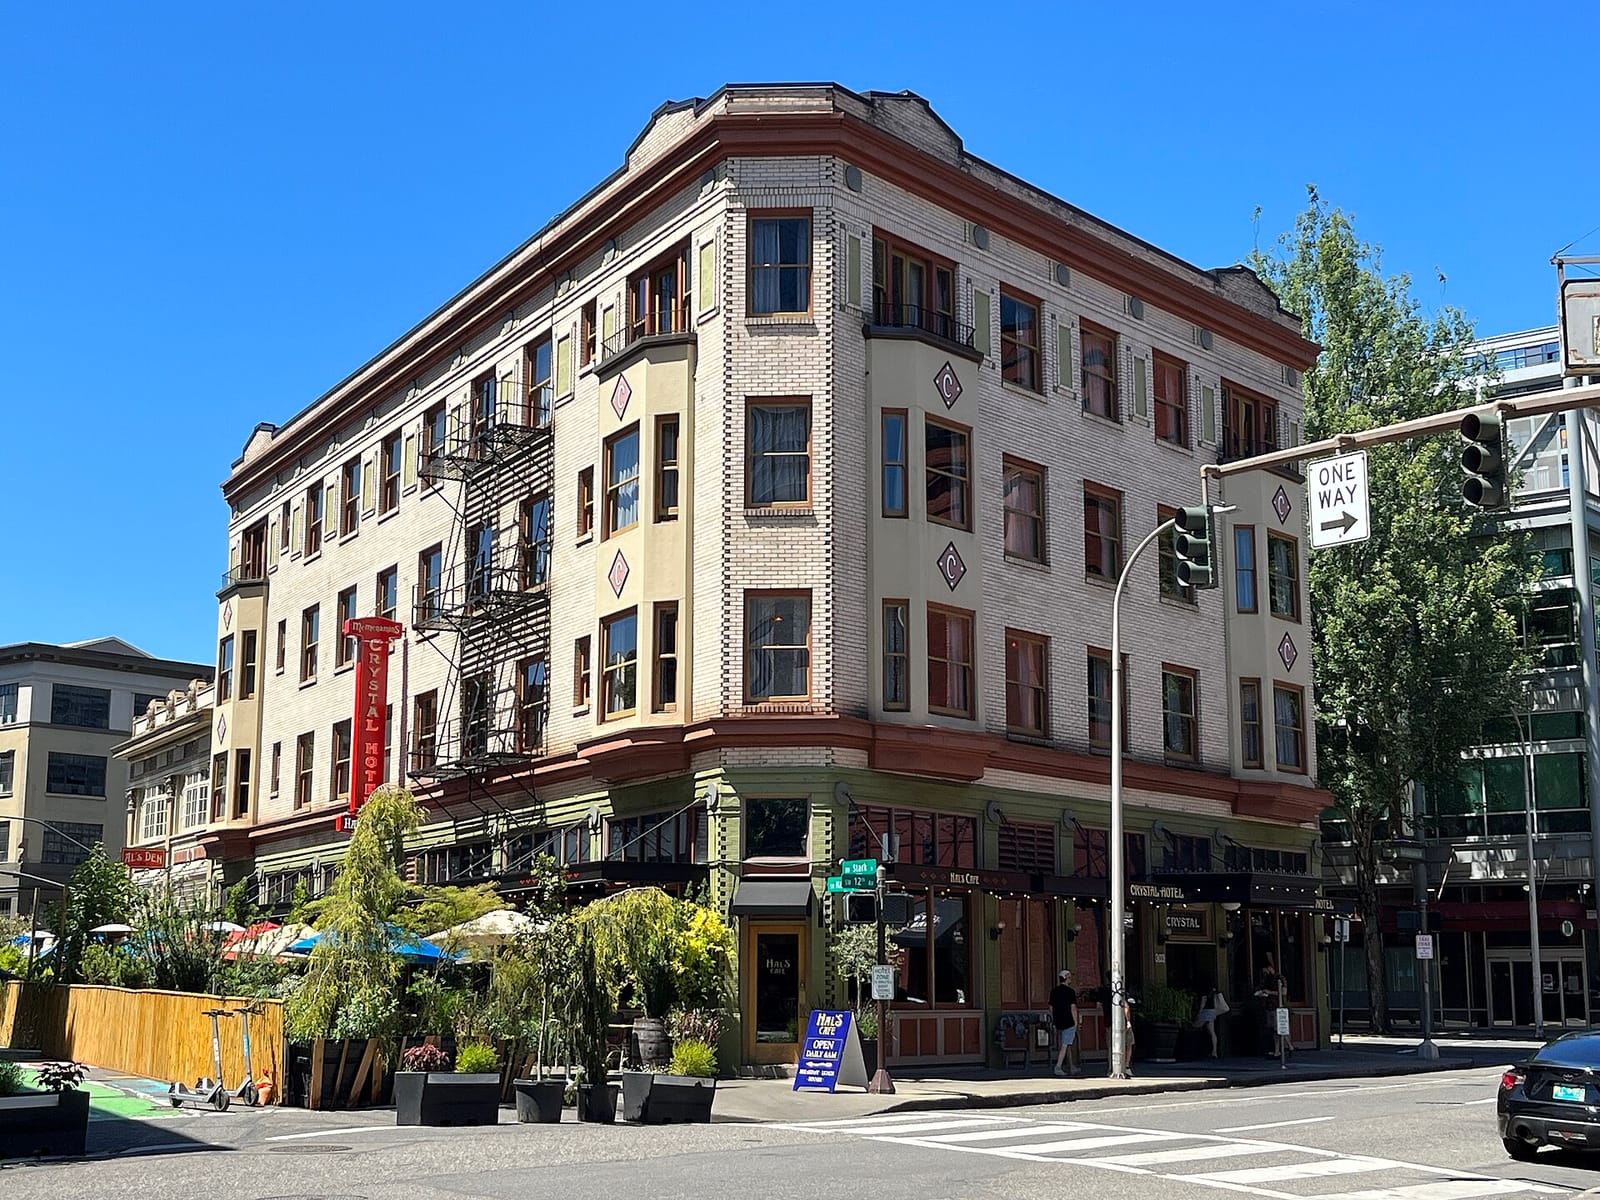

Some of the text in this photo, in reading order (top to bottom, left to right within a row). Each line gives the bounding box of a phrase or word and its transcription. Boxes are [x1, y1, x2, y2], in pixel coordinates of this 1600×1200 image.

[943, 374, 953, 398] C
[1319, 462, 1356, 486] ONE
[1318, 484, 1358, 509] WAY
[947, 554, 956, 579] C
[363, 639, 382, 803] CRYSTAL HOTE
[145, 851, 163, 864] DEN
[852, 862, 868, 873] Stark
[1130, 884, 1184, 899] CRYSTAL HOTEL
[1166, 916, 1200, 928] CRYSTAL
[818, 1027, 836, 1036] CAFE
[813, 1040, 835, 1050] OPEN
